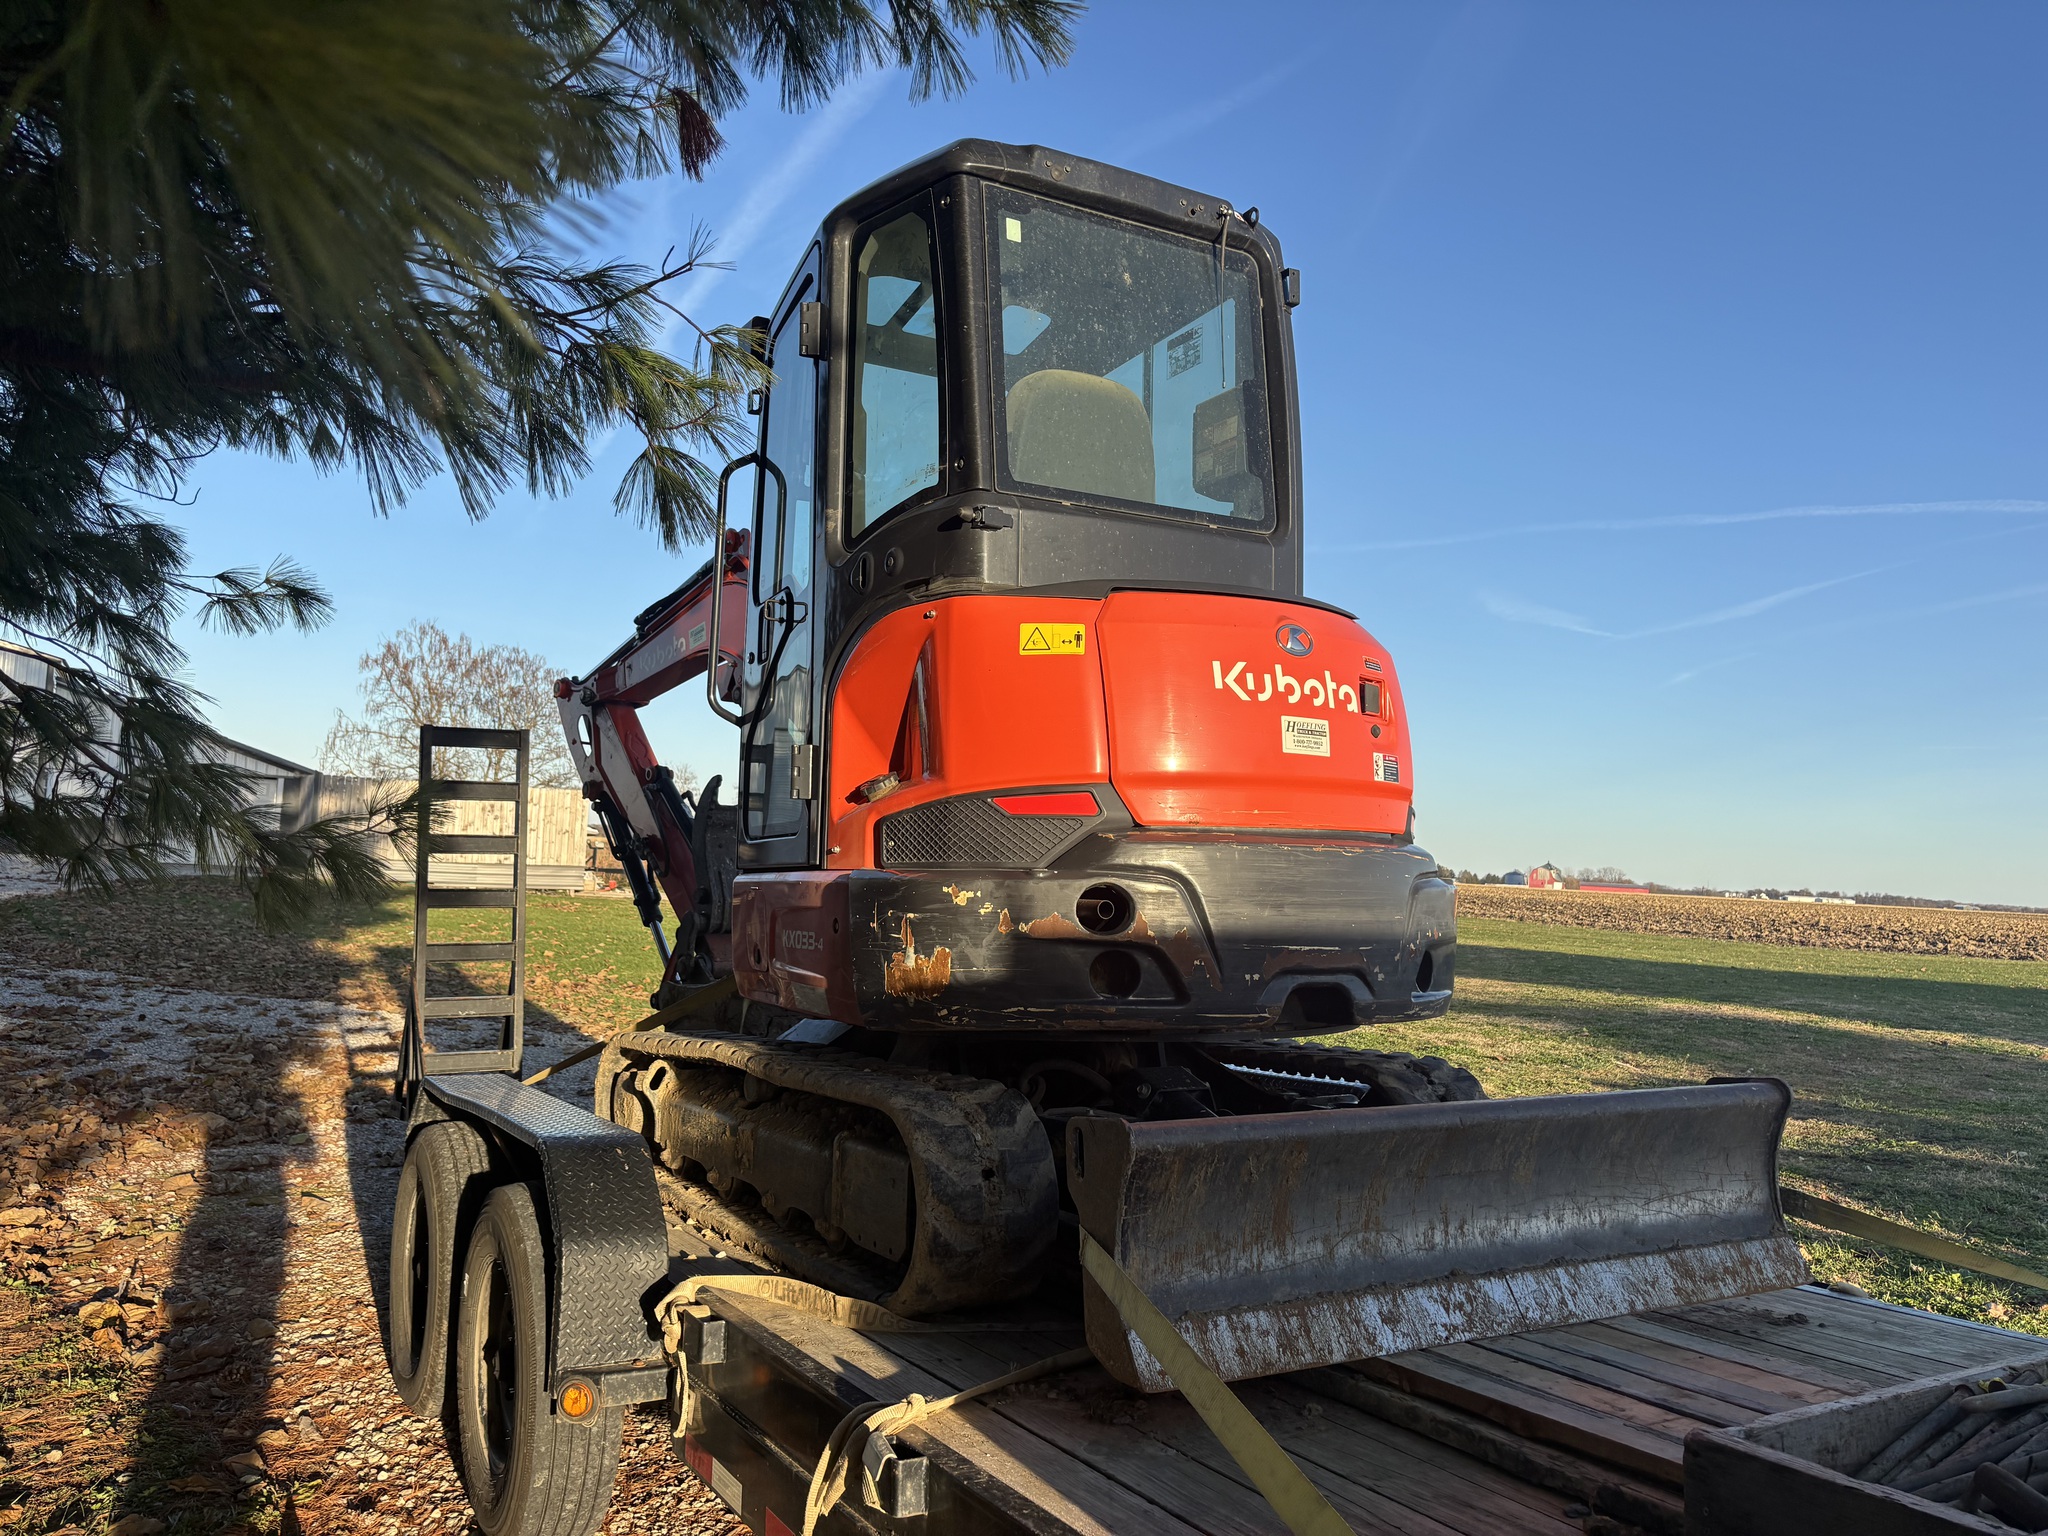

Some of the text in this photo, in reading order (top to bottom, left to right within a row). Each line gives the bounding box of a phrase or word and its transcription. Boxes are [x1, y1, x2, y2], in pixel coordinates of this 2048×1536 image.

[640, 635, 686, 671] Kubota
[1212, 660, 1358, 713] Kubota
[782, 929, 824, 951] KX033-4
